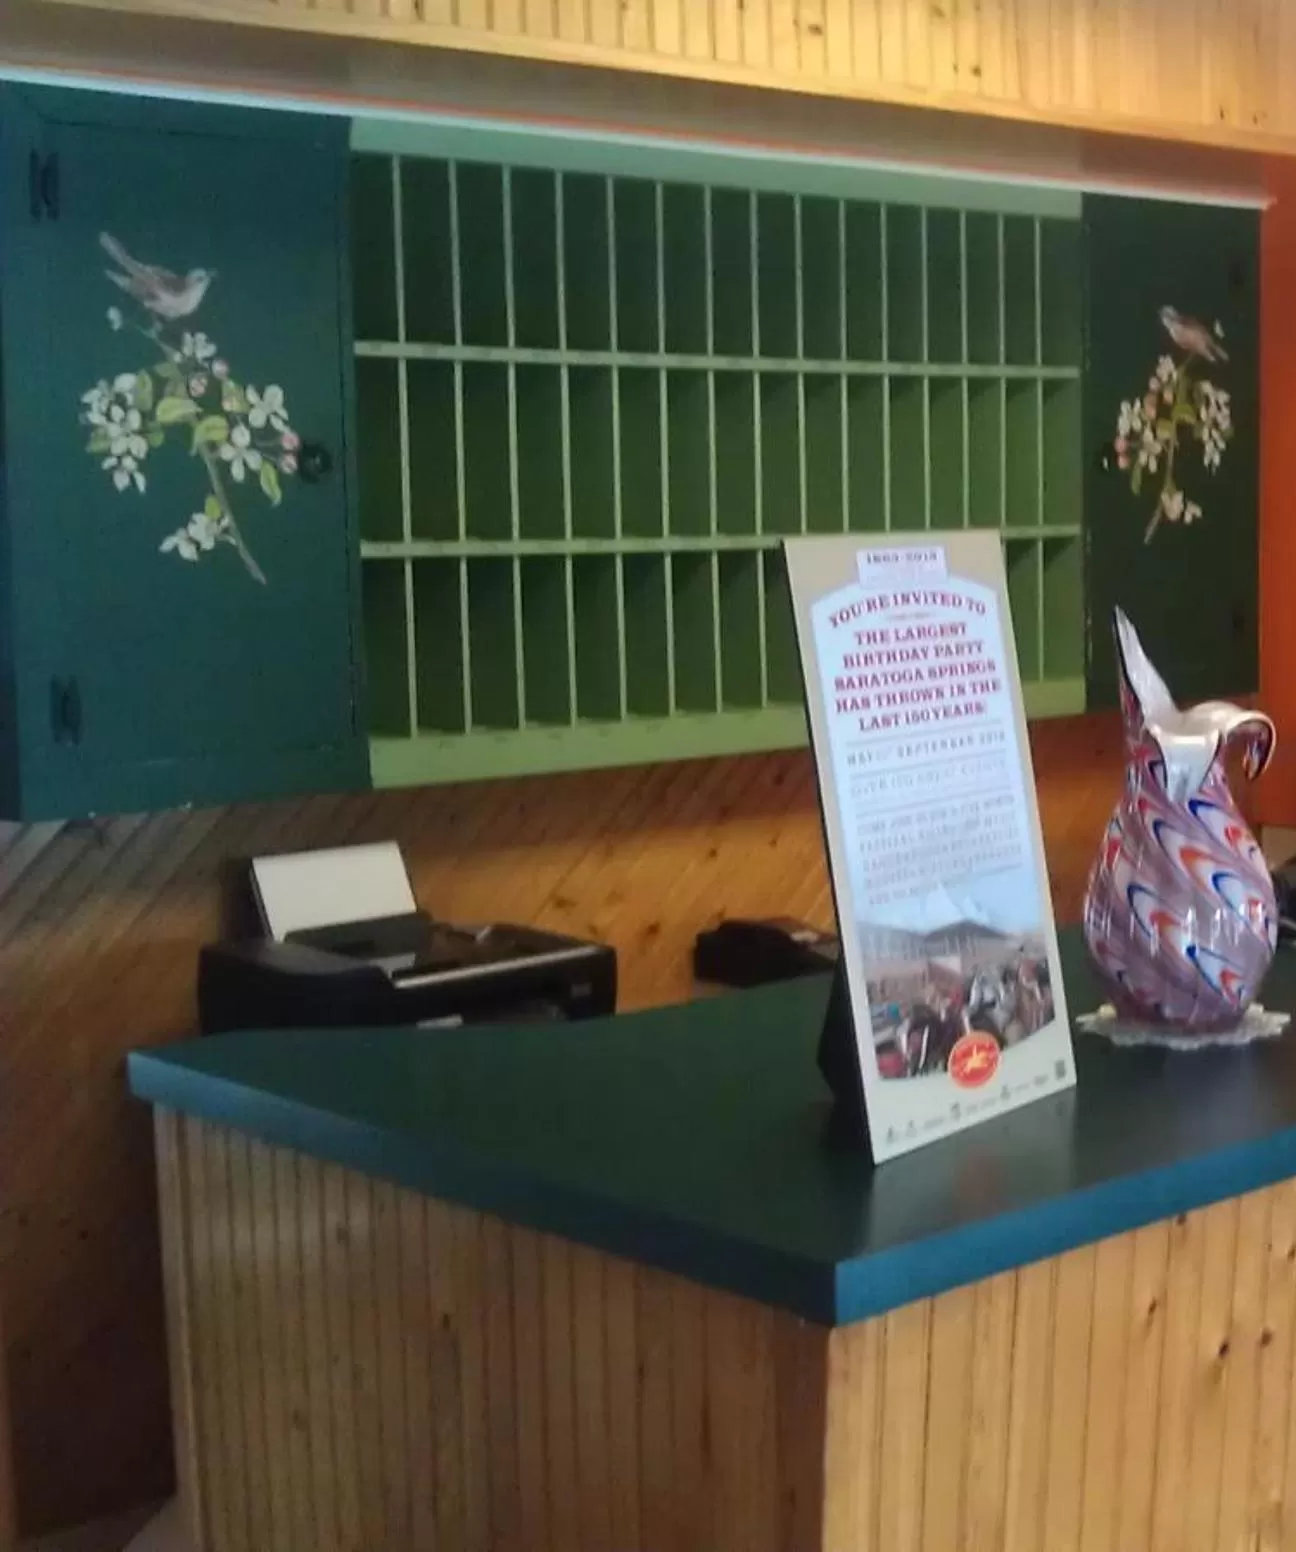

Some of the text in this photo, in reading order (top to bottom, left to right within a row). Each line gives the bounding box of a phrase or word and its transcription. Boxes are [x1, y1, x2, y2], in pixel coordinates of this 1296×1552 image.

[893, 590, 963, 608] INVITED
[967, 596, 987, 616] TO
[854, 621, 968, 646] THE LARGEST
[843, 639, 984, 669] BIRTHDAY PARTY
[834, 658, 997, 692] SARATOGA SPRINGS
[835, 678, 1001, 713] HAS THROWN IN THE
[859, 711, 900, 731] LAST
[904, 706, 931, 725] 150
